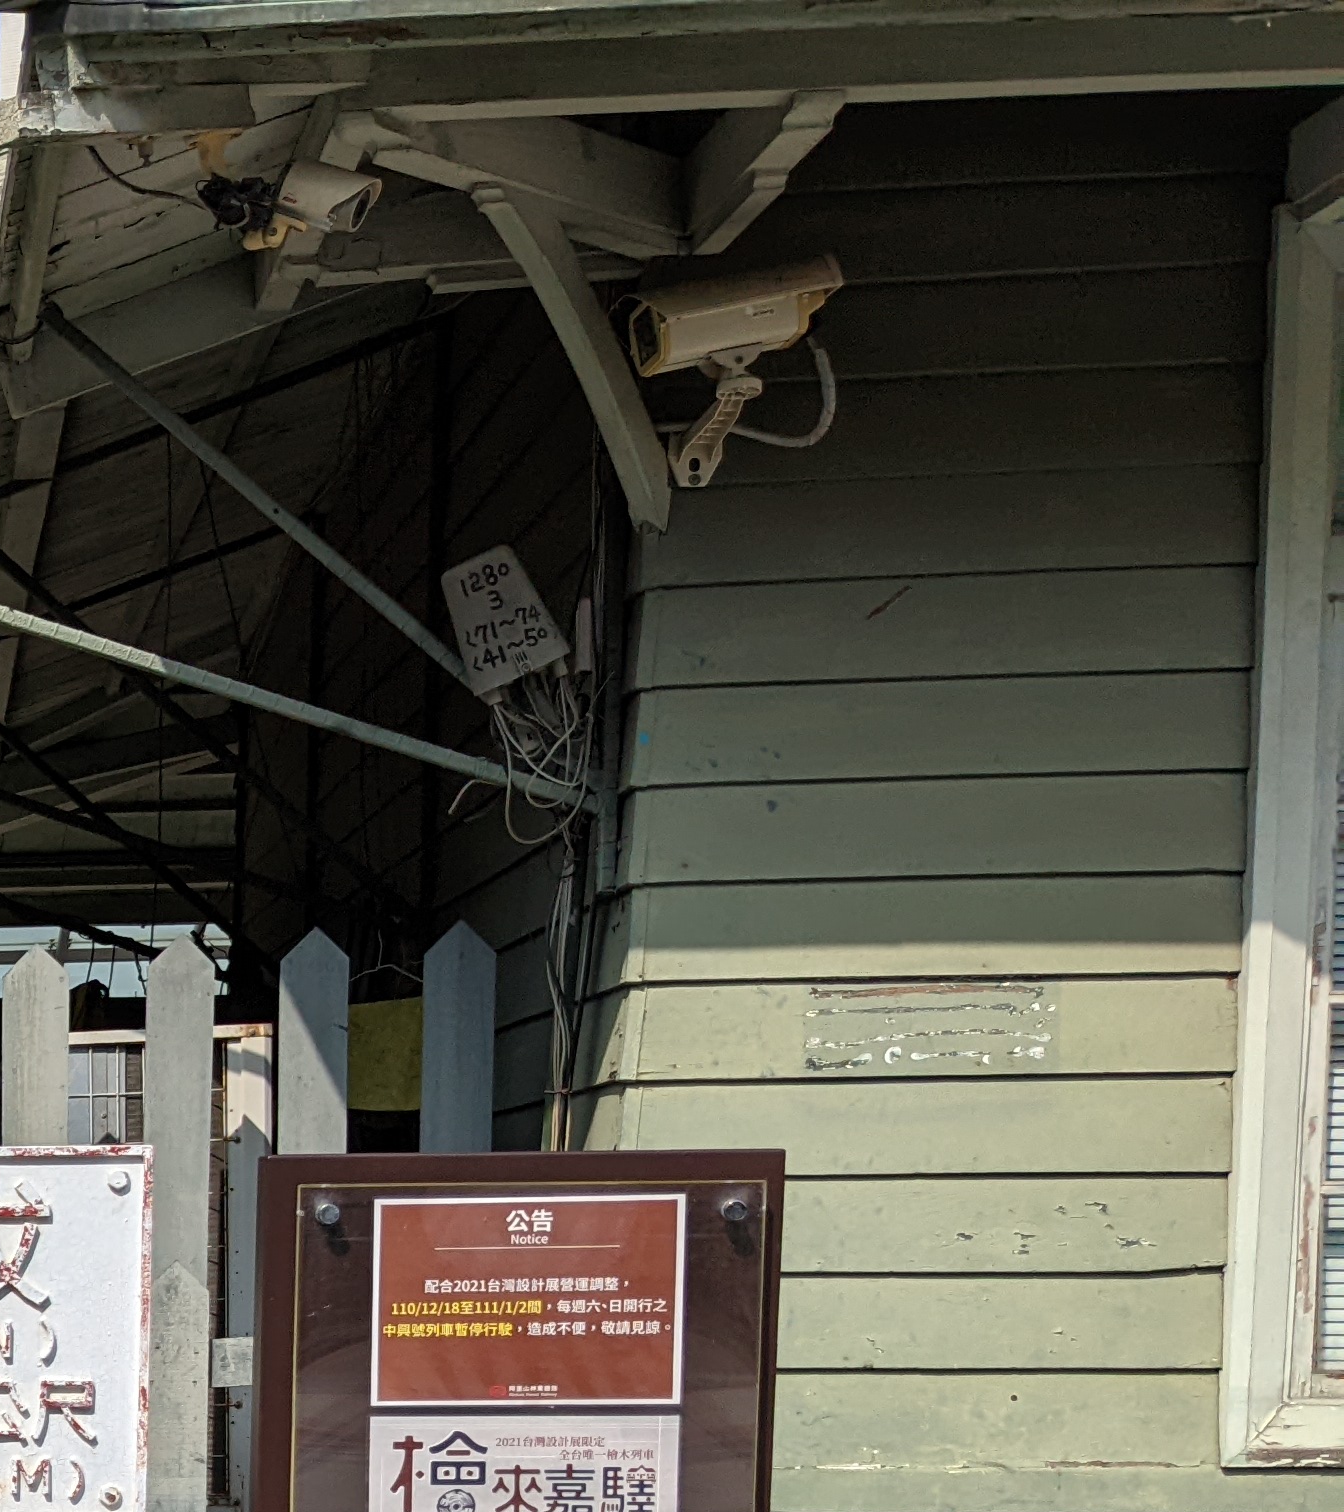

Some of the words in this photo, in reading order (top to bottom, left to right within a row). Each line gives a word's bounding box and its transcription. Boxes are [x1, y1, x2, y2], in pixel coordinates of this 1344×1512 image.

[461, 563, 509, 597] 1280
[488, 590, 503, 610] 3
[506, 1210, 553, 1232] 公告
[511, 1233, 548, 1245] Notice
